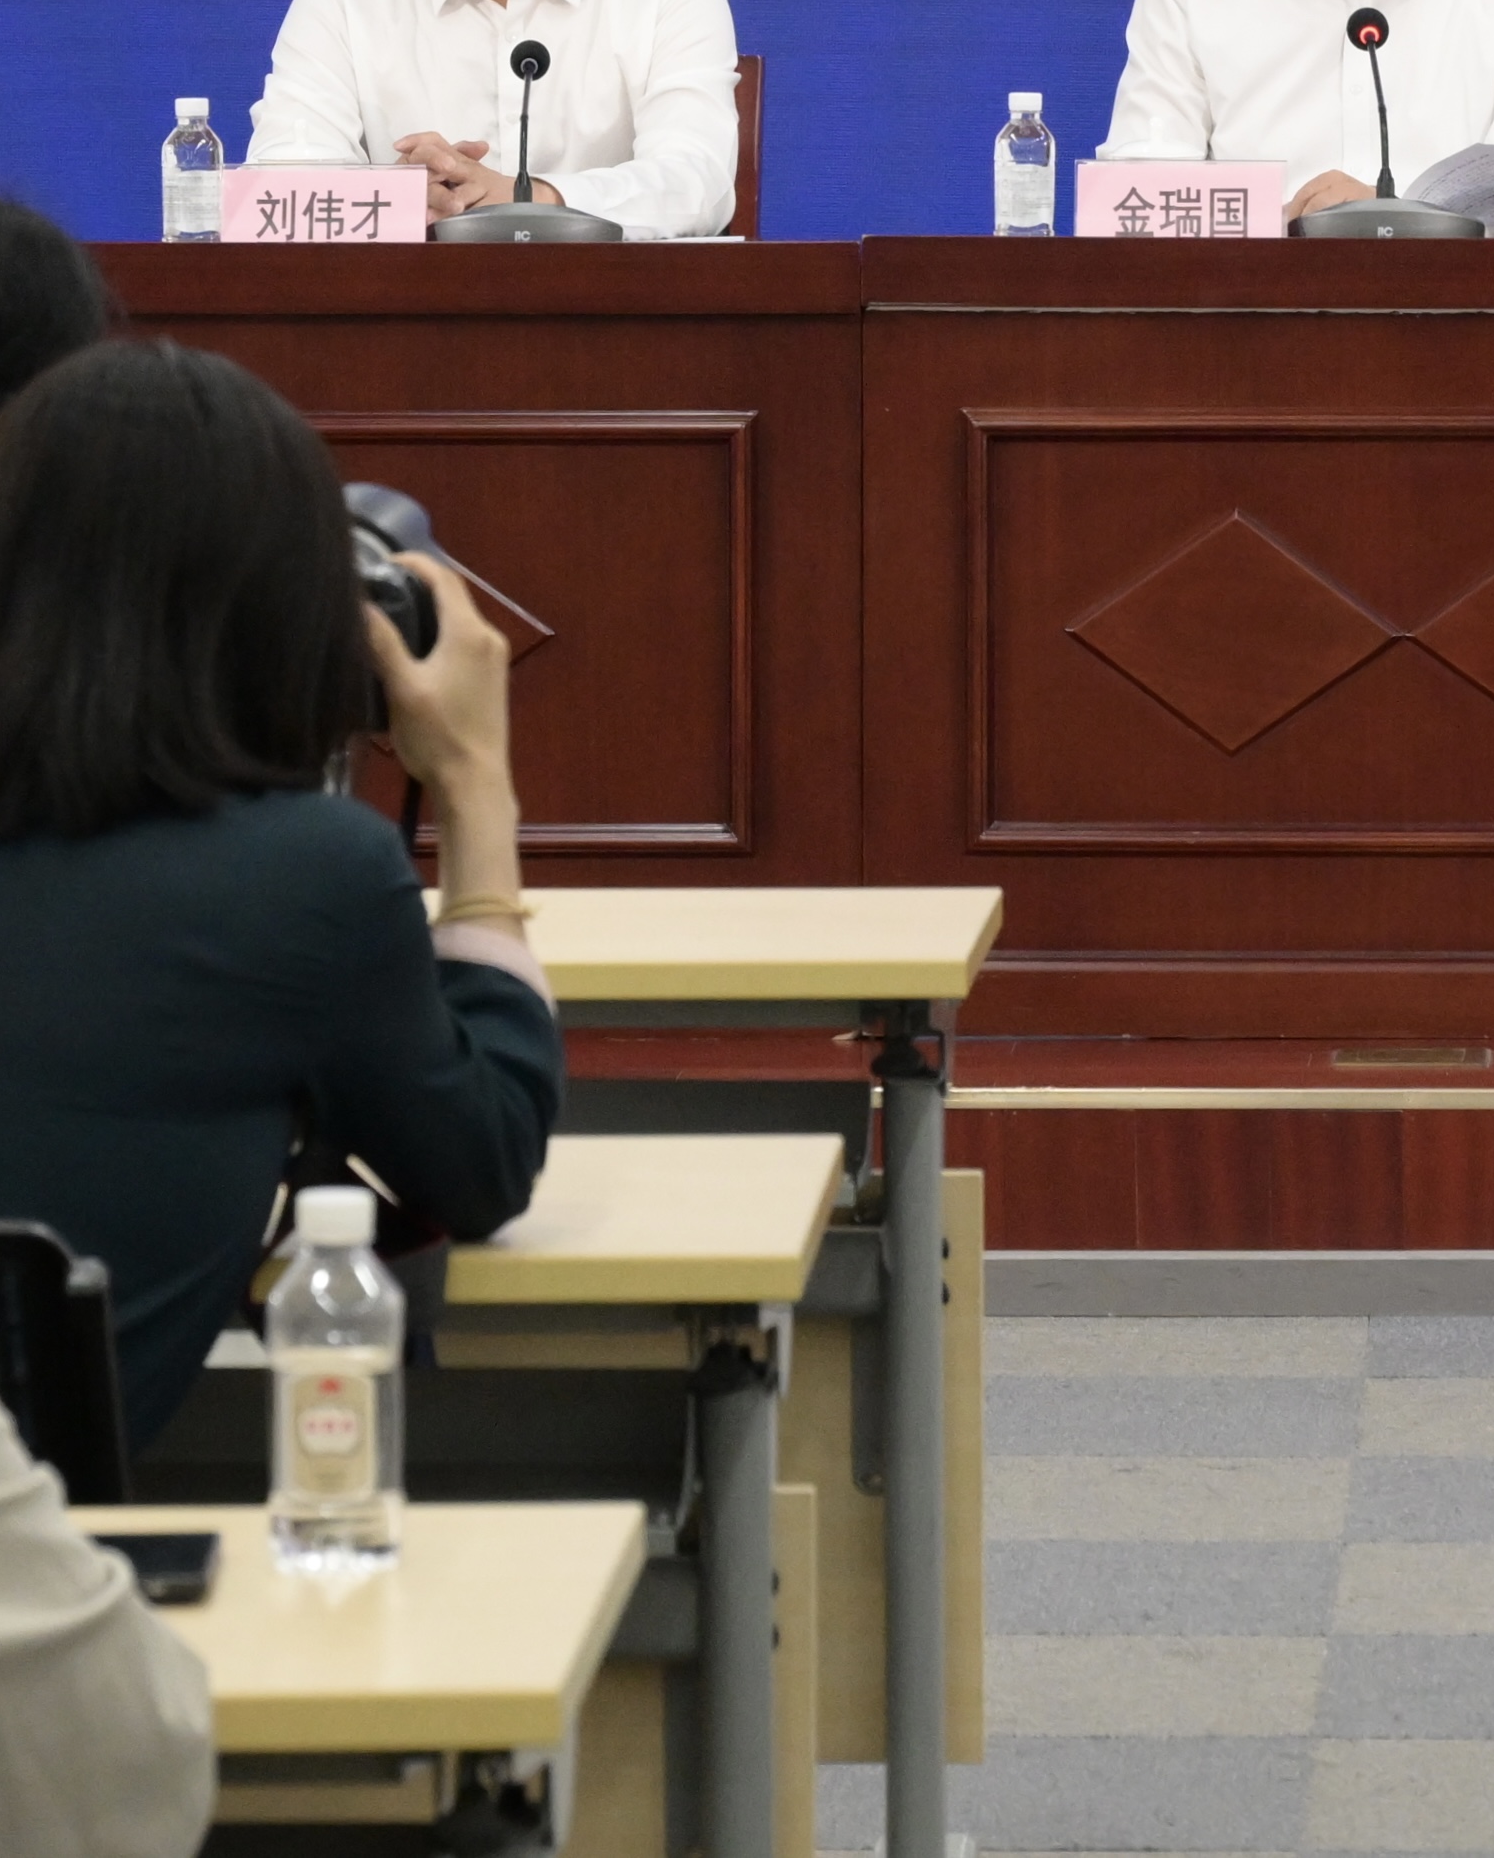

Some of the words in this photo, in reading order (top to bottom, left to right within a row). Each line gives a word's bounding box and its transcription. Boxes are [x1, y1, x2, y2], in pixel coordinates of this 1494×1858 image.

[255, 188, 393, 241] 刘伟才
[1112, 186, 1249, 238] 金瑞国
